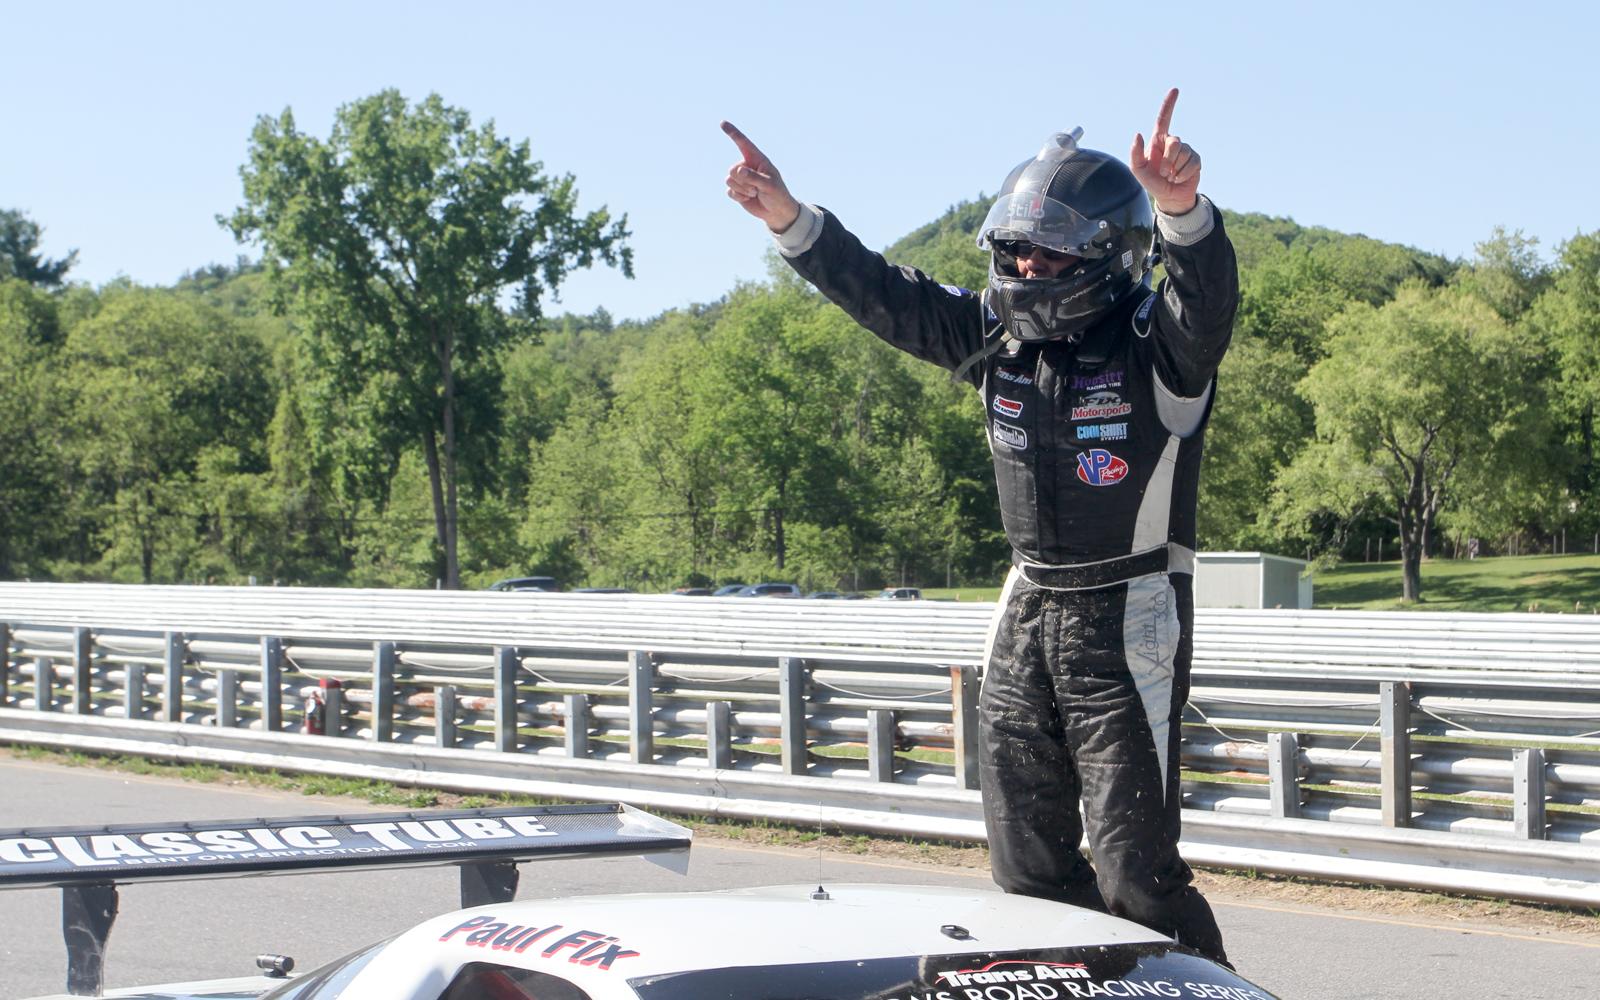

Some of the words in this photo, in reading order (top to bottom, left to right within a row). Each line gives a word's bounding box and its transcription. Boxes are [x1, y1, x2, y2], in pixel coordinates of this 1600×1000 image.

[1072, 403, 1131, 419] Motorsports
[1077, 449, 1112, 485] VP
[0, 826, 341, 867] CLASSIC
[354, 815, 559, 850] TUBE
[123, 855, 190, 866] BENT
[198, 853, 234, 861] ON
[240, 846, 390, 859] PERFECTION
[438, 915, 564, 954] Paul
[541, 929, 641, 971] Fix
[938, 969, 1033, 988] Trans
[1034, 964, 1091, 981] Am
[963, 983, 1058, 1000] ROAD
[1062, 980, 1180, 998] RACING
